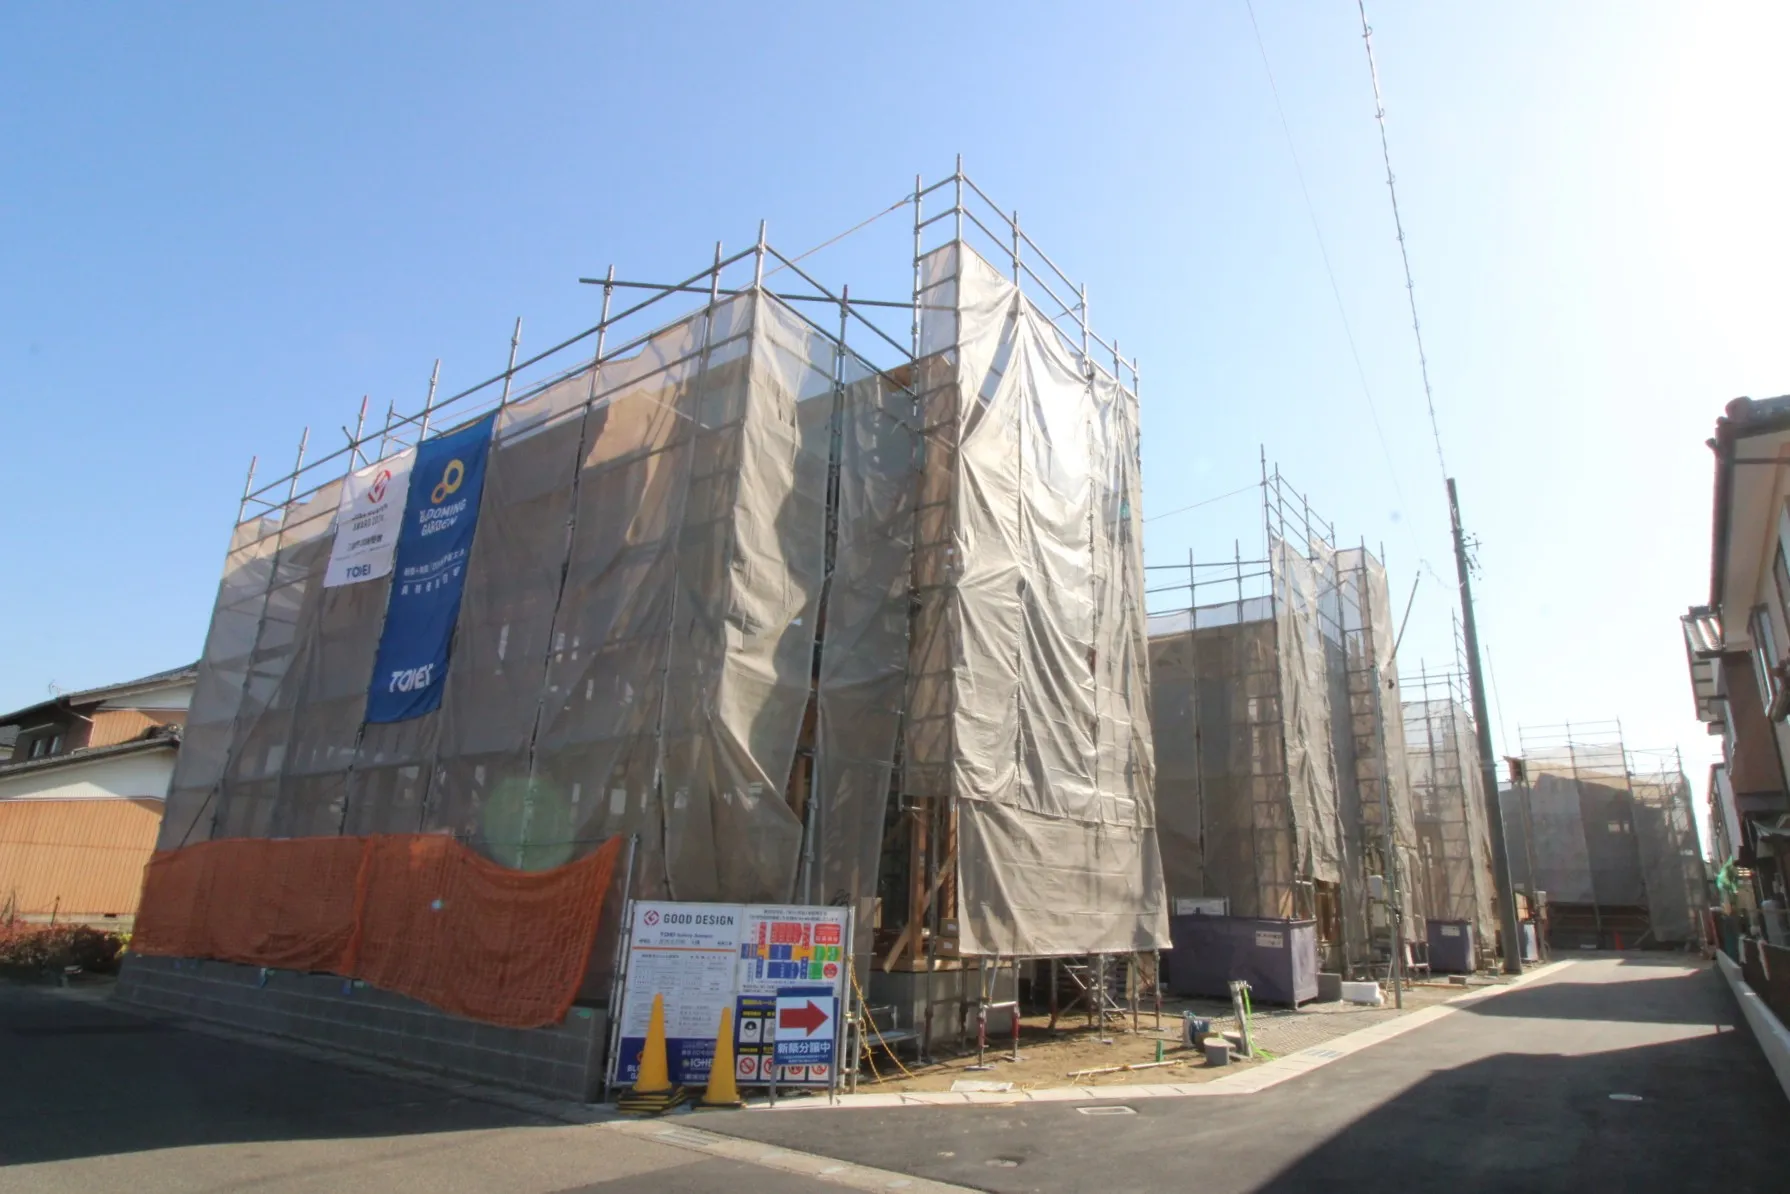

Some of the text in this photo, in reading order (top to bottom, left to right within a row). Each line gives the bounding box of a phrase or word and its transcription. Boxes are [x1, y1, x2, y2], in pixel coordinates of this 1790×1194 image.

[421, 516, 458, 536] GARDEN
[663, 913, 693, 925] GOOD
[695, 914, 735, 926] DESIGN
